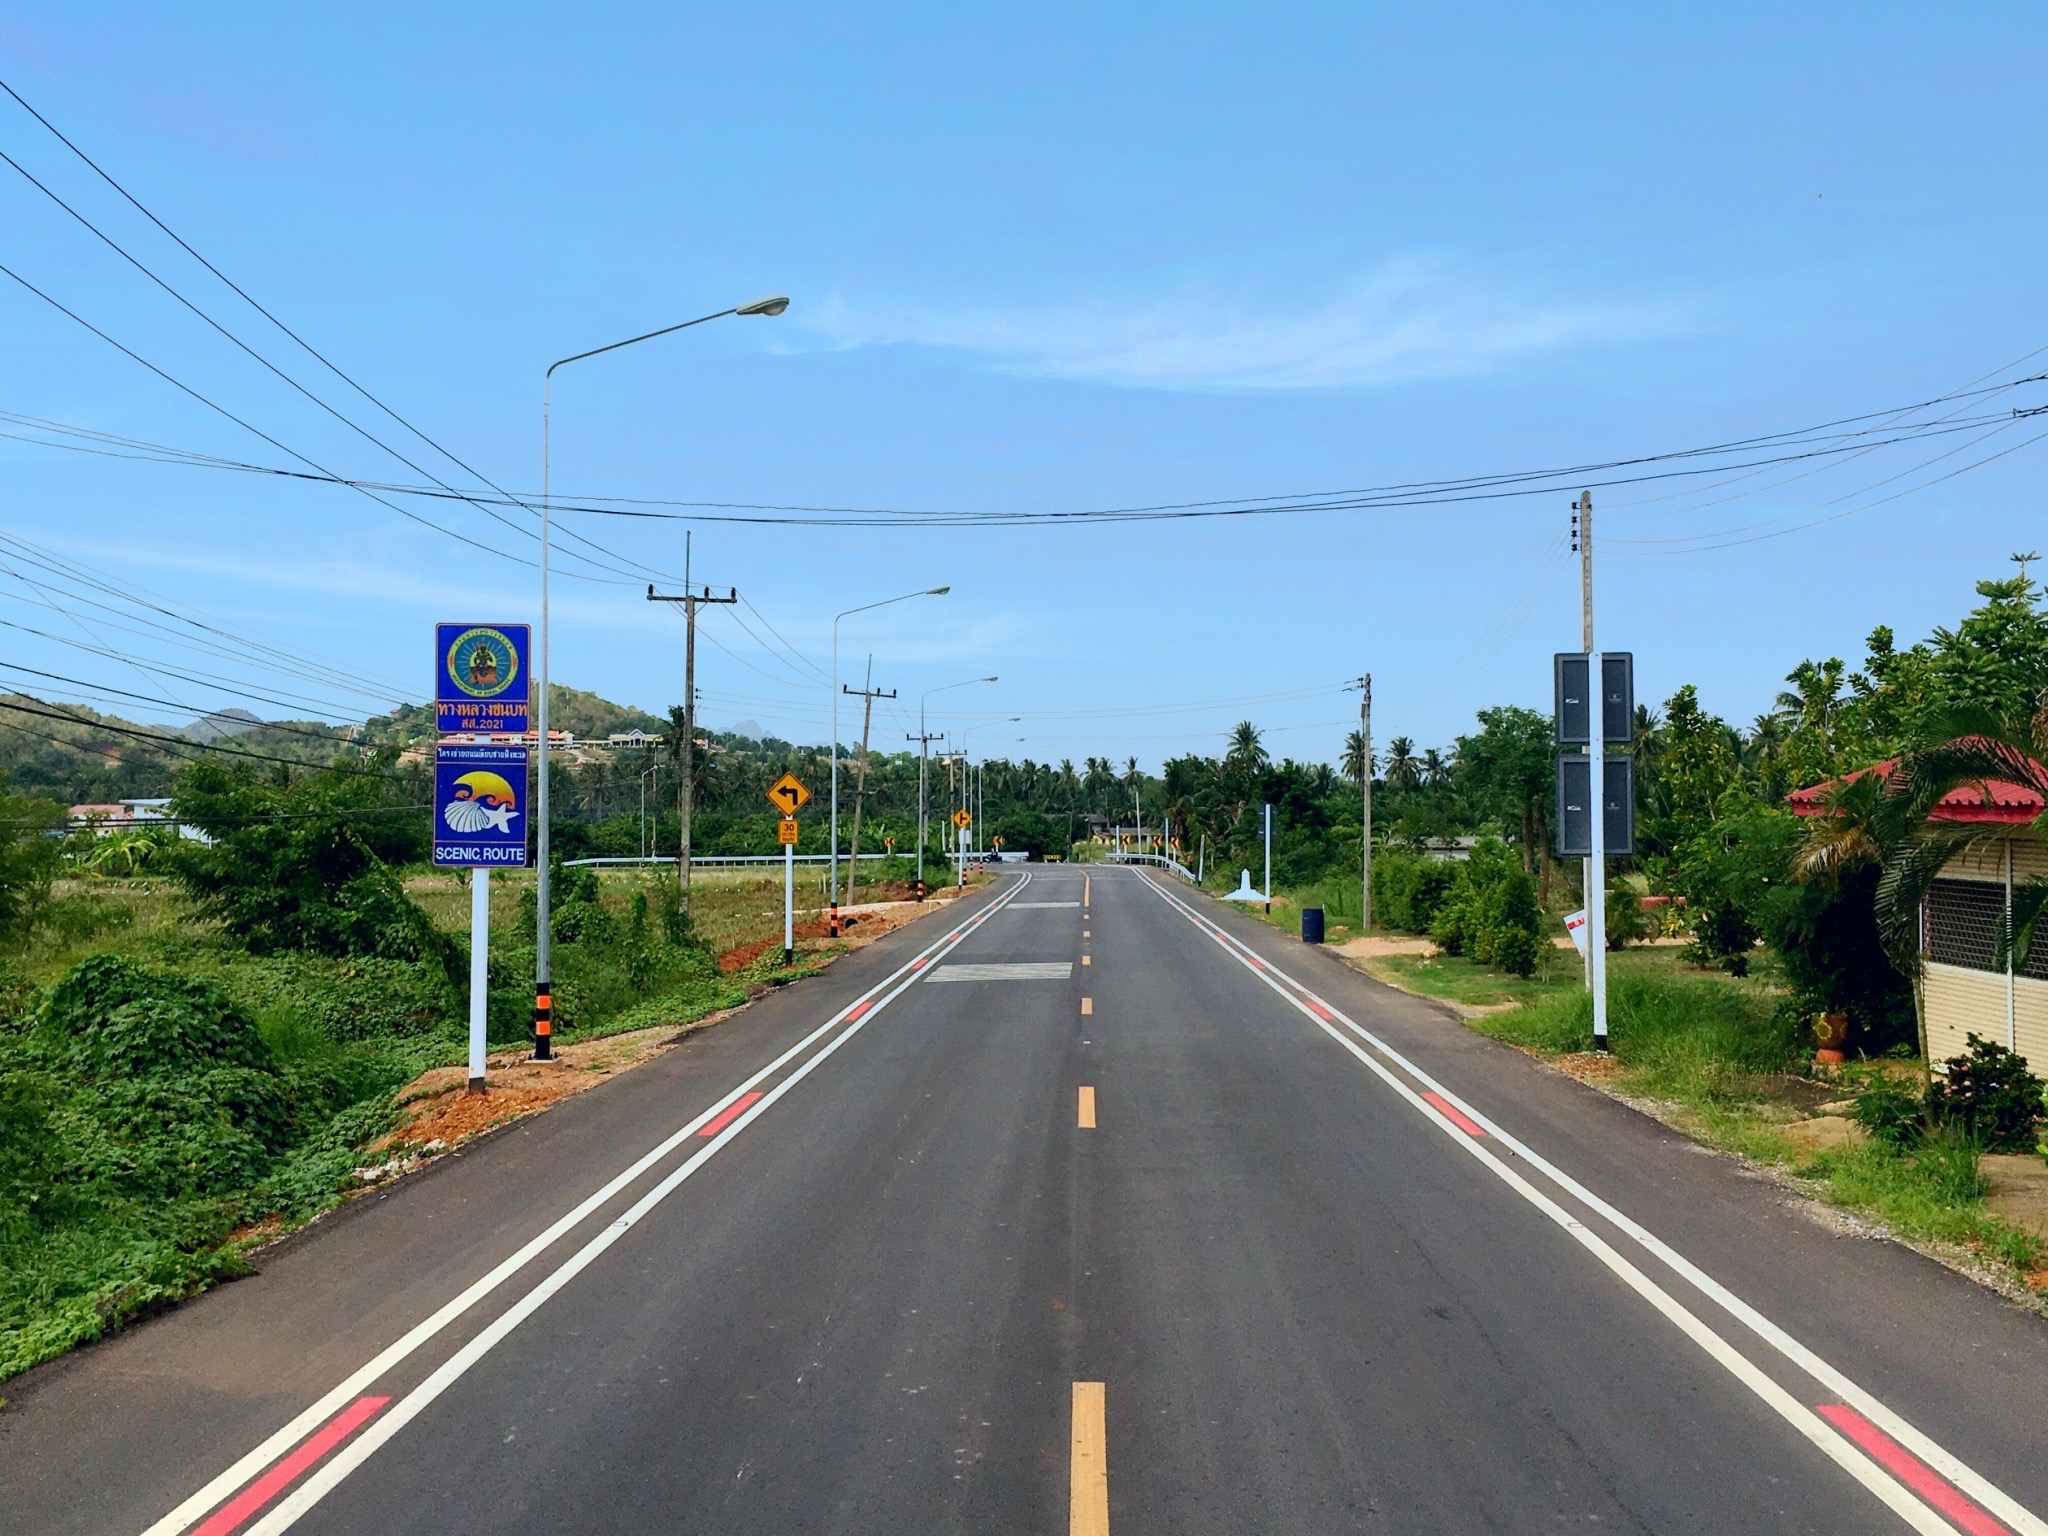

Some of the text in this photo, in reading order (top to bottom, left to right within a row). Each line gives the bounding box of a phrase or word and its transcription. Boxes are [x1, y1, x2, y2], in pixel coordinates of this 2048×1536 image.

[438, 703, 528, 716] ทางหลวงชนบท
[784, 823, 794, 831] 30
[435, 847, 524, 861] SCENIC ROUTE
